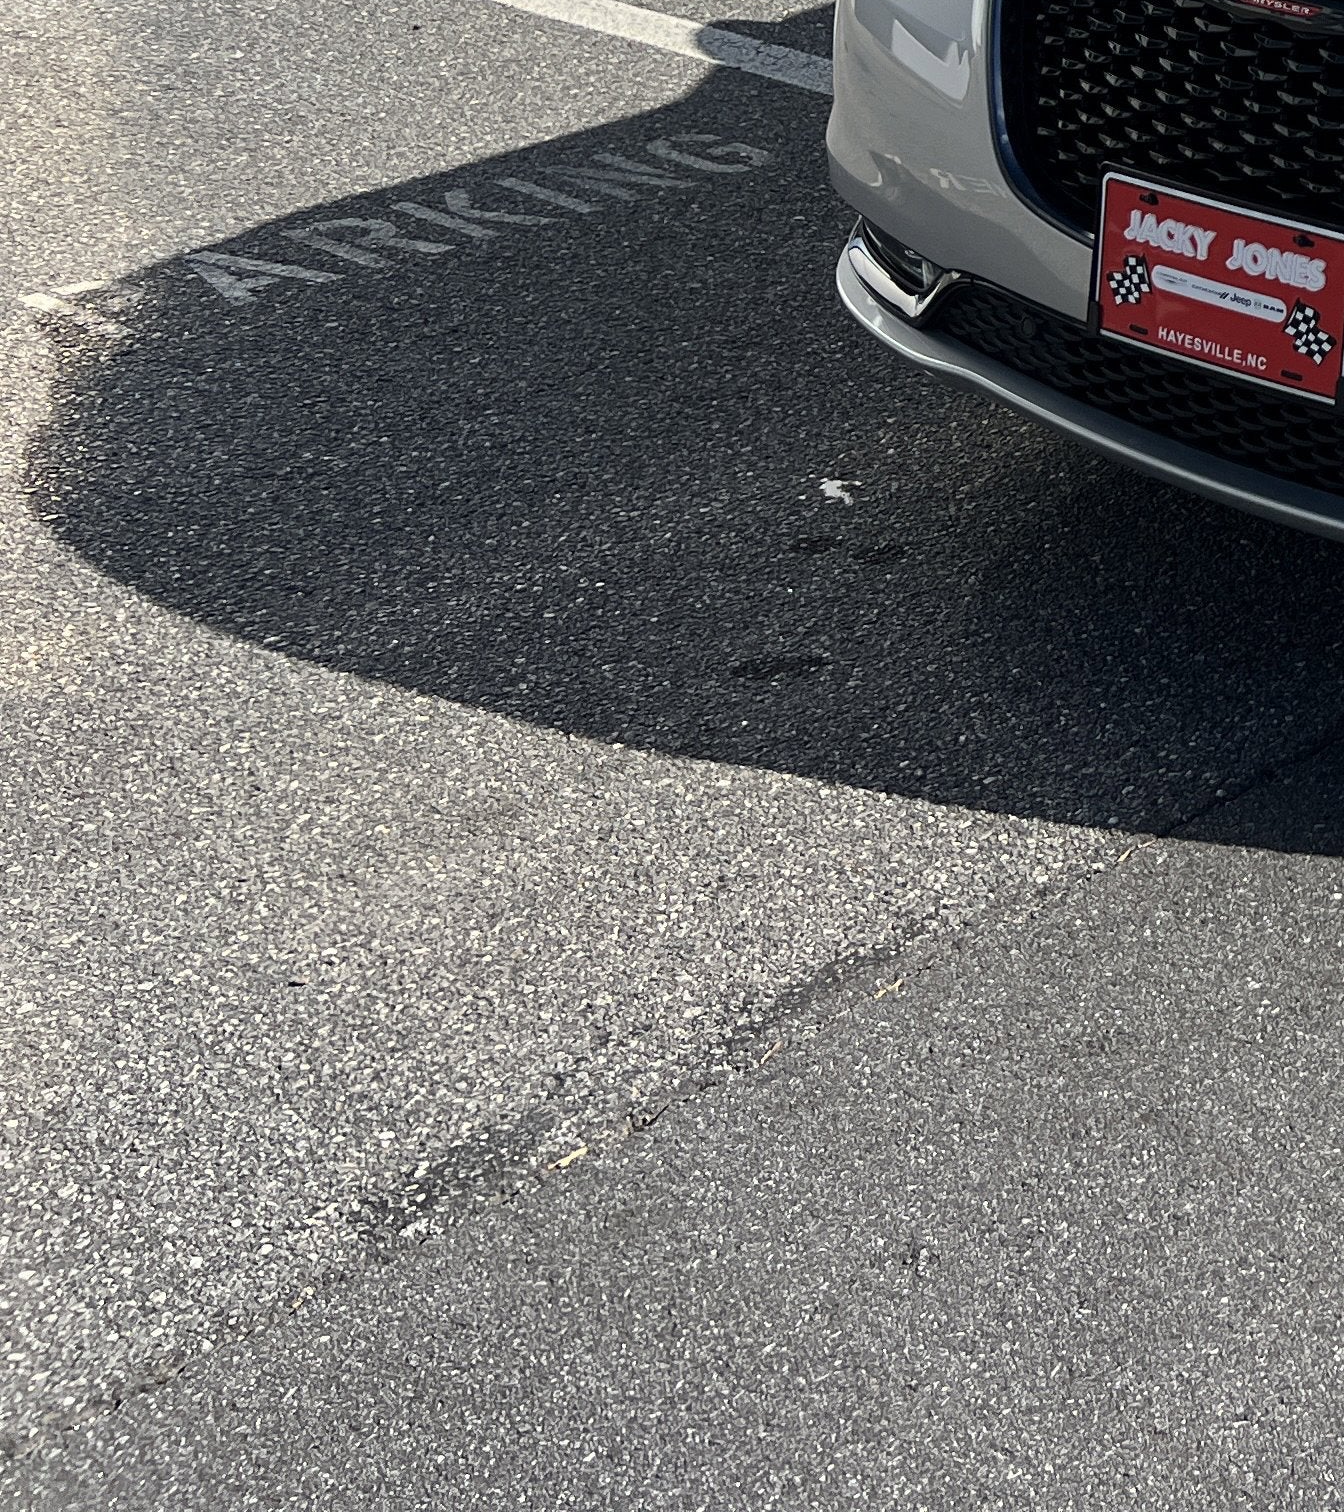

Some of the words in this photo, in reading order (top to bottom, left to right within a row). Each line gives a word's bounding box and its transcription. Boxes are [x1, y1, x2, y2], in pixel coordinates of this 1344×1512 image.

[1123, 209, 1218, 261] JACKY
[1225, 238, 1327, 292] JONES
[1230, 292, 1252, 307] Jeep
